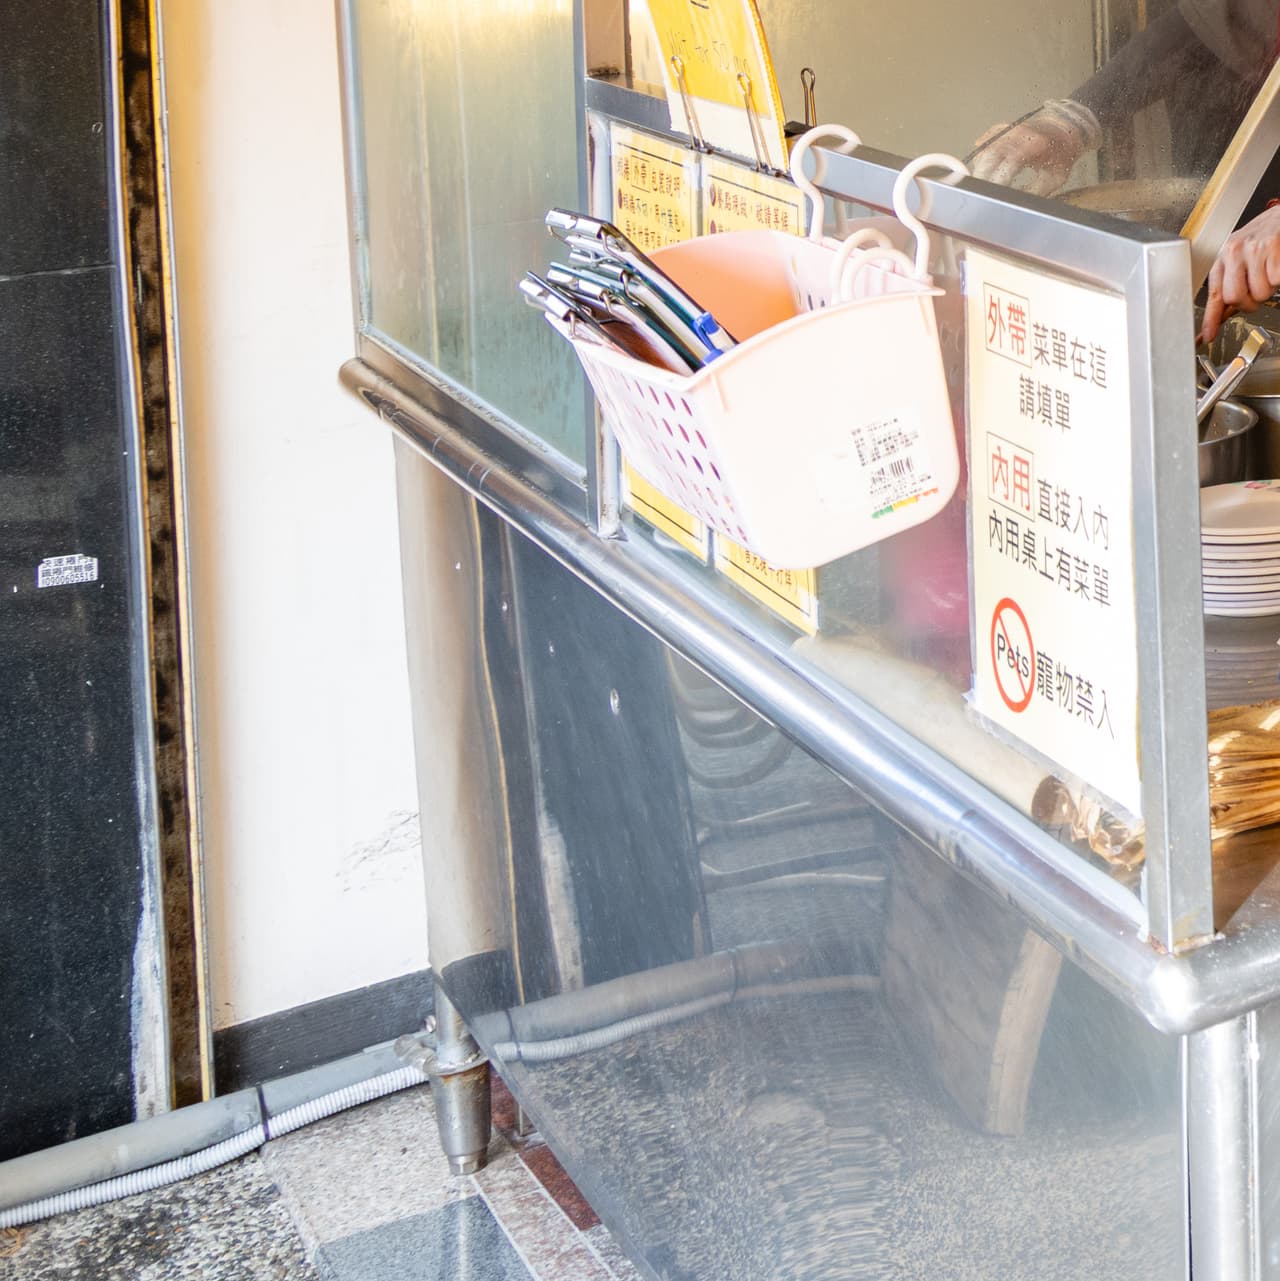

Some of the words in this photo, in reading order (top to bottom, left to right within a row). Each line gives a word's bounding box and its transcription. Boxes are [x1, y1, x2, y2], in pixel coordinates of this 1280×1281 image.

[987, 294, 1027, 357] 外帶
[1032, 322, 1107, 389] 菜單在這
[1019, 373, 1071, 431] 請填單
[997, 633, 1030, 678] Pets
[1036, 650, 1115, 740] 寵物禁入
